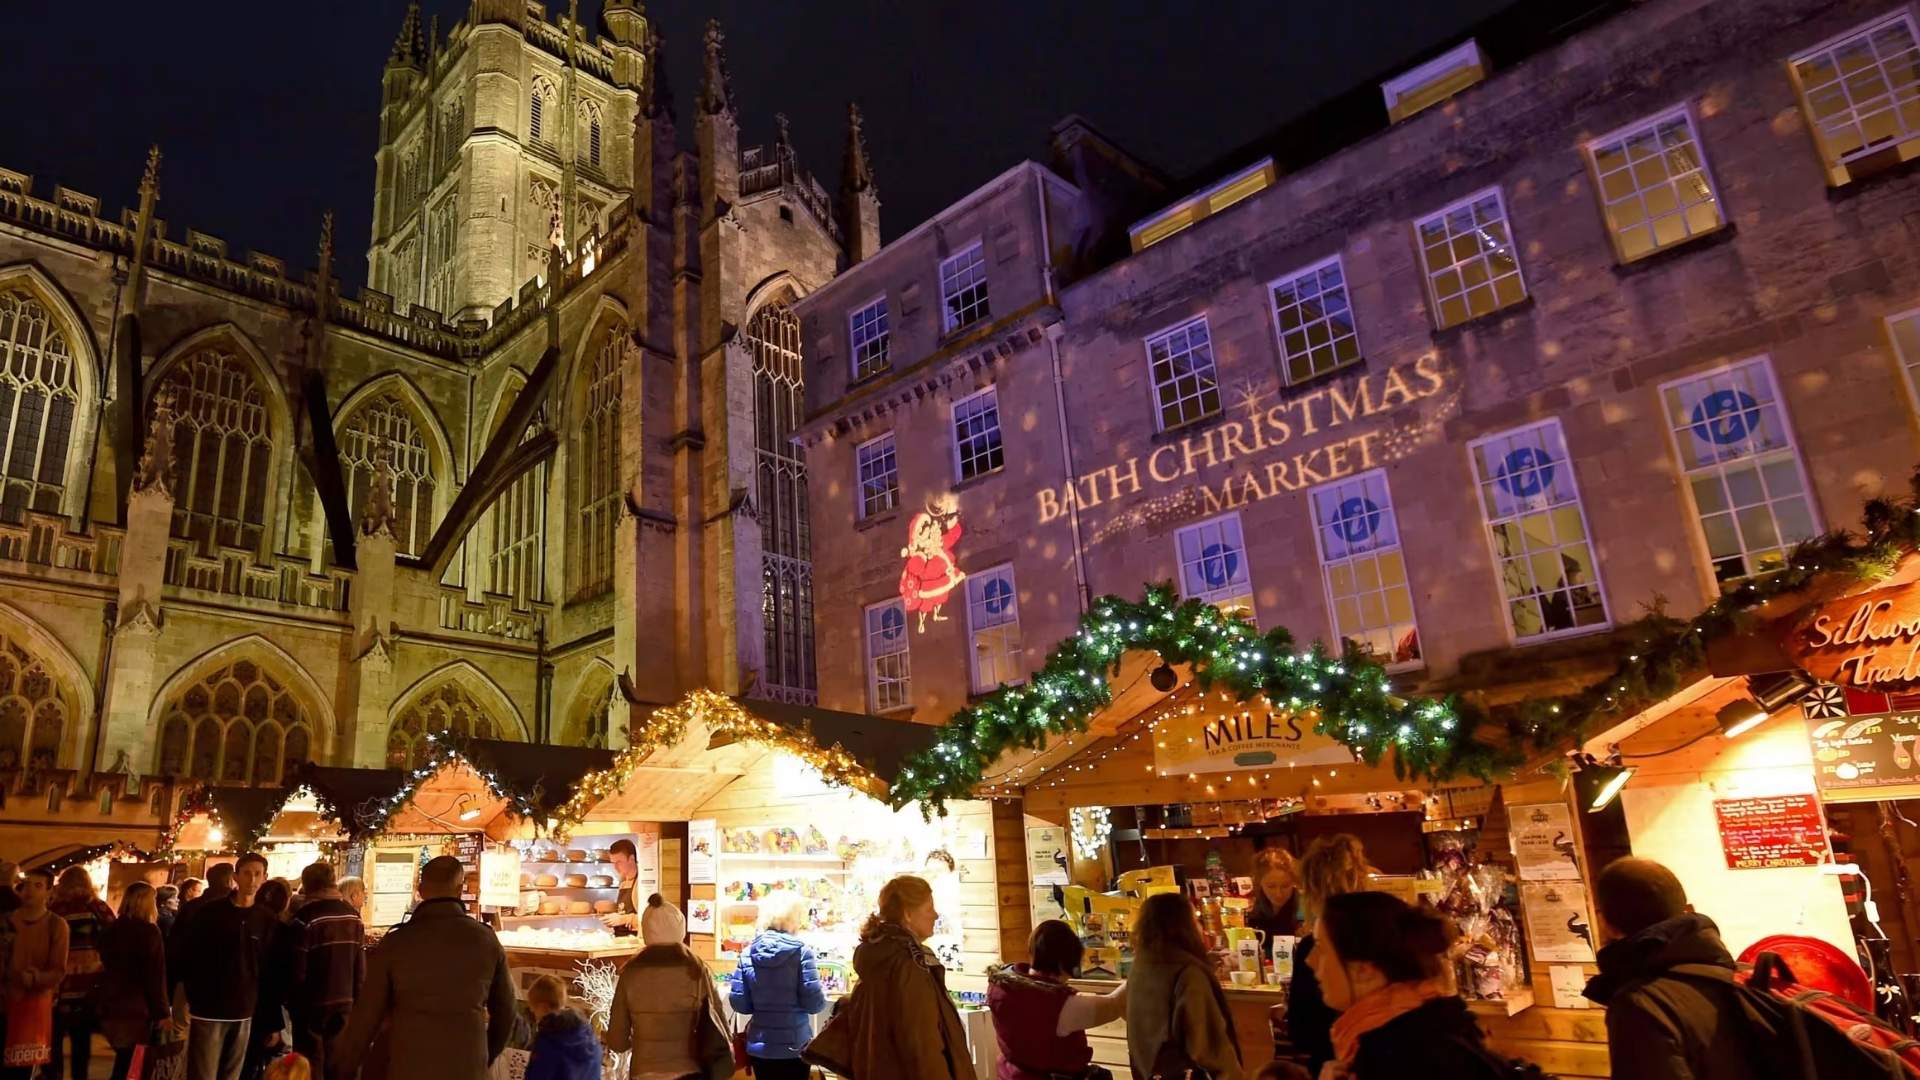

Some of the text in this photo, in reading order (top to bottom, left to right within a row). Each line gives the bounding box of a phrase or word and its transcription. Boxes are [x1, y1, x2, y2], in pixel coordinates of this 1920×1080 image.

[1036, 350, 1445, 525] BATH CHRISTMAS
[1199, 431, 1380, 517] MARKET
[1203, 713, 1304, 749] MILES
[1228, 743, 1253, 752] COFFEE
[1735, 858, 1806, 868] MERRY CHRISTMAS
